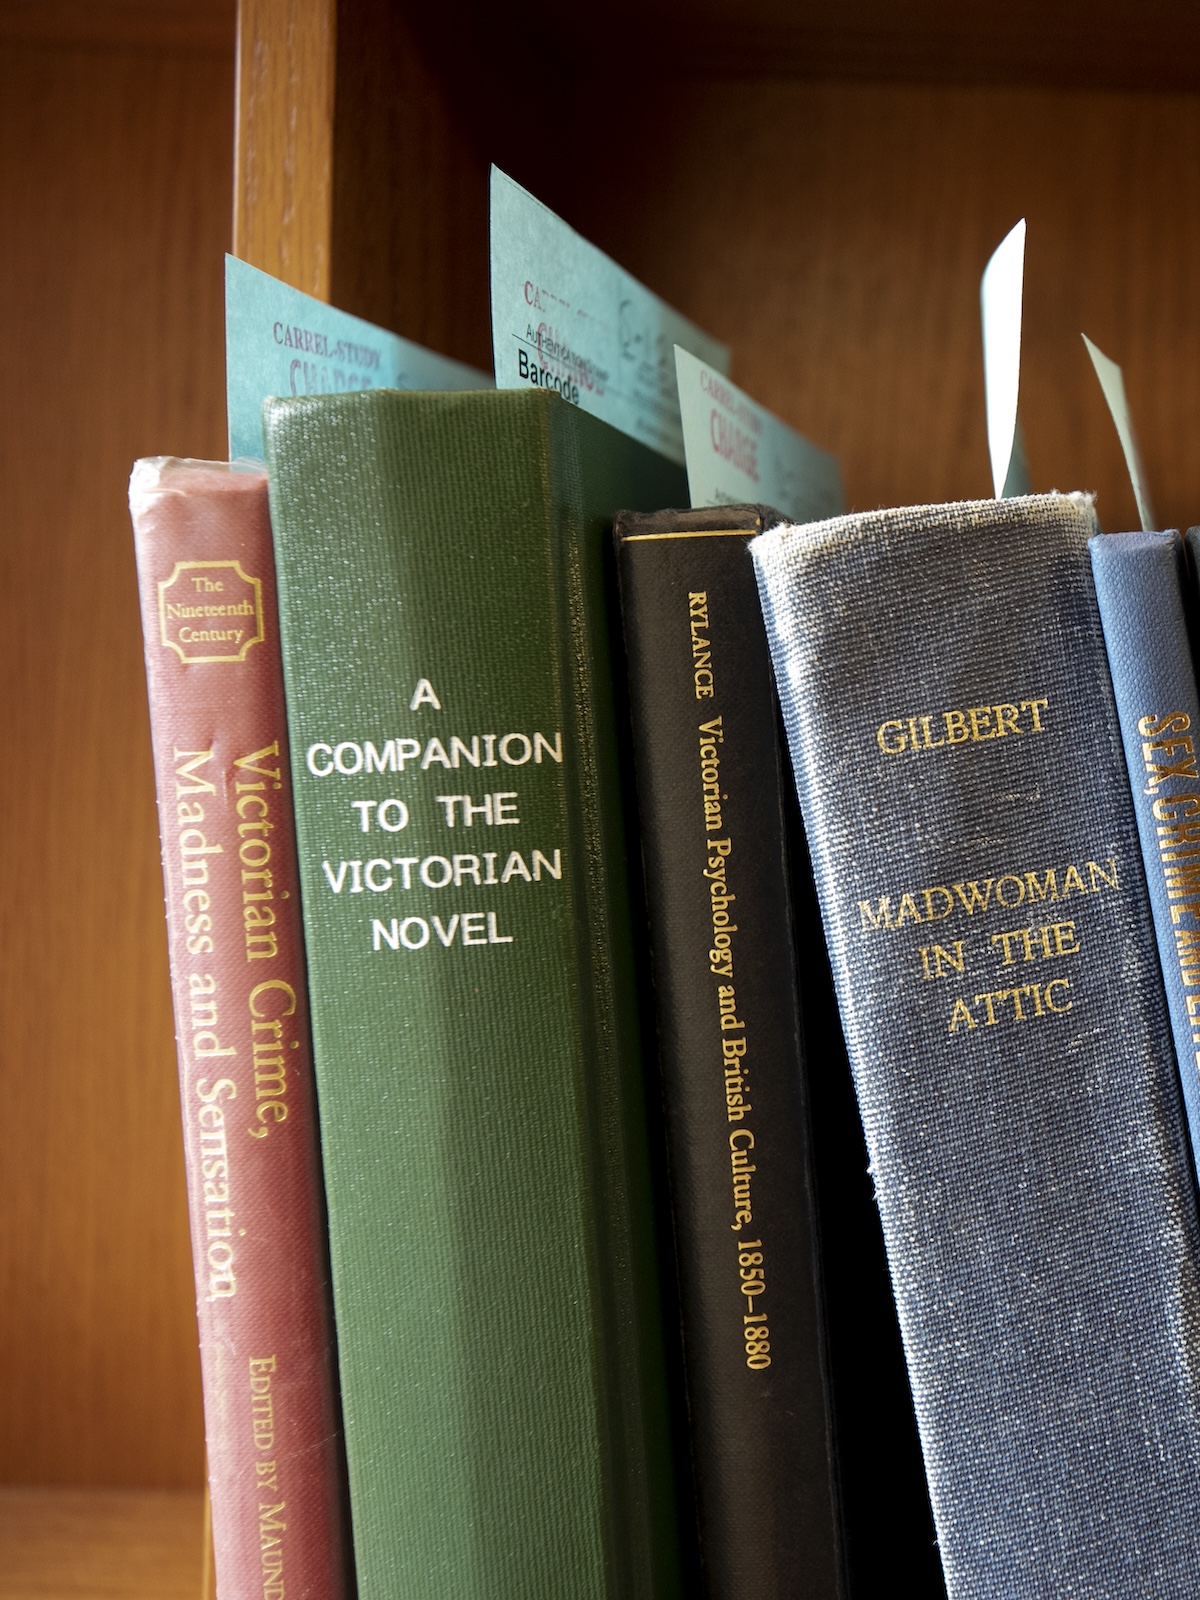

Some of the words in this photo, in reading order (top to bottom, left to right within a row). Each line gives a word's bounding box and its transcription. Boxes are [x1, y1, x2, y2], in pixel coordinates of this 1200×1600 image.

[166, 599, 256, 619] Nineteenth
[191, 576, 224, 593] The
[178, 626, 244, 644] Century
[687, 590, 715, 700] RYLANCE
[410, 678, 442, 711] A
[877, 698, 1050, 755] GILBERT
[306, 731, 563, 777] COMPANION
[698, 715, 729, 832] Victorian
[1137, 710, 1199, 795] SEX,
[351, 798, 409, 833] TO
[435, 792, 520, 827] THE
[173, 746, 224, 956] Madness
[233, 740, 290, 963] Victorian
[321, 849, 563, 893] VICTORIAN
[703, 837, 738, 978] Psychology
[858, 857, 1121, 932] MADWOMAN
[372, 911, 514, 951] NOVEL
[918, 940, 966, 980] IN
[991, 920, 1081, 967] THE
[188, 972, 237, 1061] and
[718, 985, 746, 1031] and
[948, 978, 1074, 1033] ATTIC
[247, 979, 300, 1139] Crime,
[722, 1037, 752, 1122] British
[196, 1078, 246, 1303] Sensation
[728, 1129, 757, 1231] Culture,
[249, 1354, 277, 1450] EDITED
[255, 1460, 279, 1492] BY
